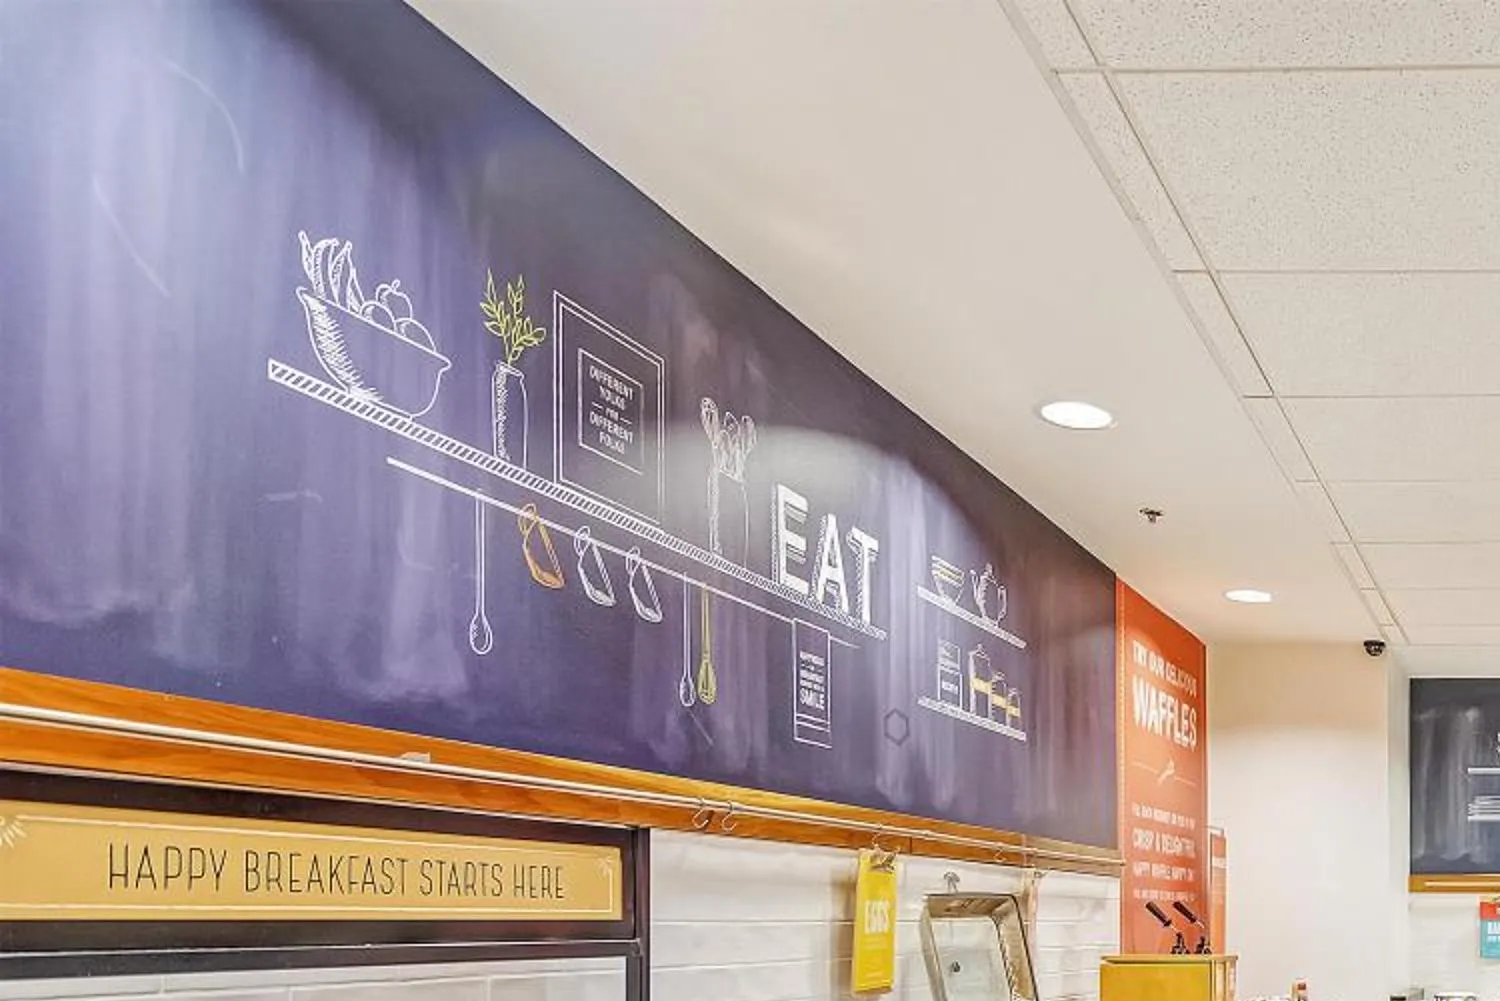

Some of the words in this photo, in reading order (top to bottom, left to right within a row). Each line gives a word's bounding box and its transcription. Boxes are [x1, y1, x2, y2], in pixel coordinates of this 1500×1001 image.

[589, 365, 633, 401] DIFFERENT
[589, 411, 633, 445] DIFFERENT
[772, 483, 879, 626] EAT
[1132, 673, 1197, 754] WAFFLES
[108, 843, 227, 891] HAPPY
[244, 850, 408, 895] BREAKFAST
[419, 858, 504, 898] STARTS
[513, 864, 566, 900] HERE
